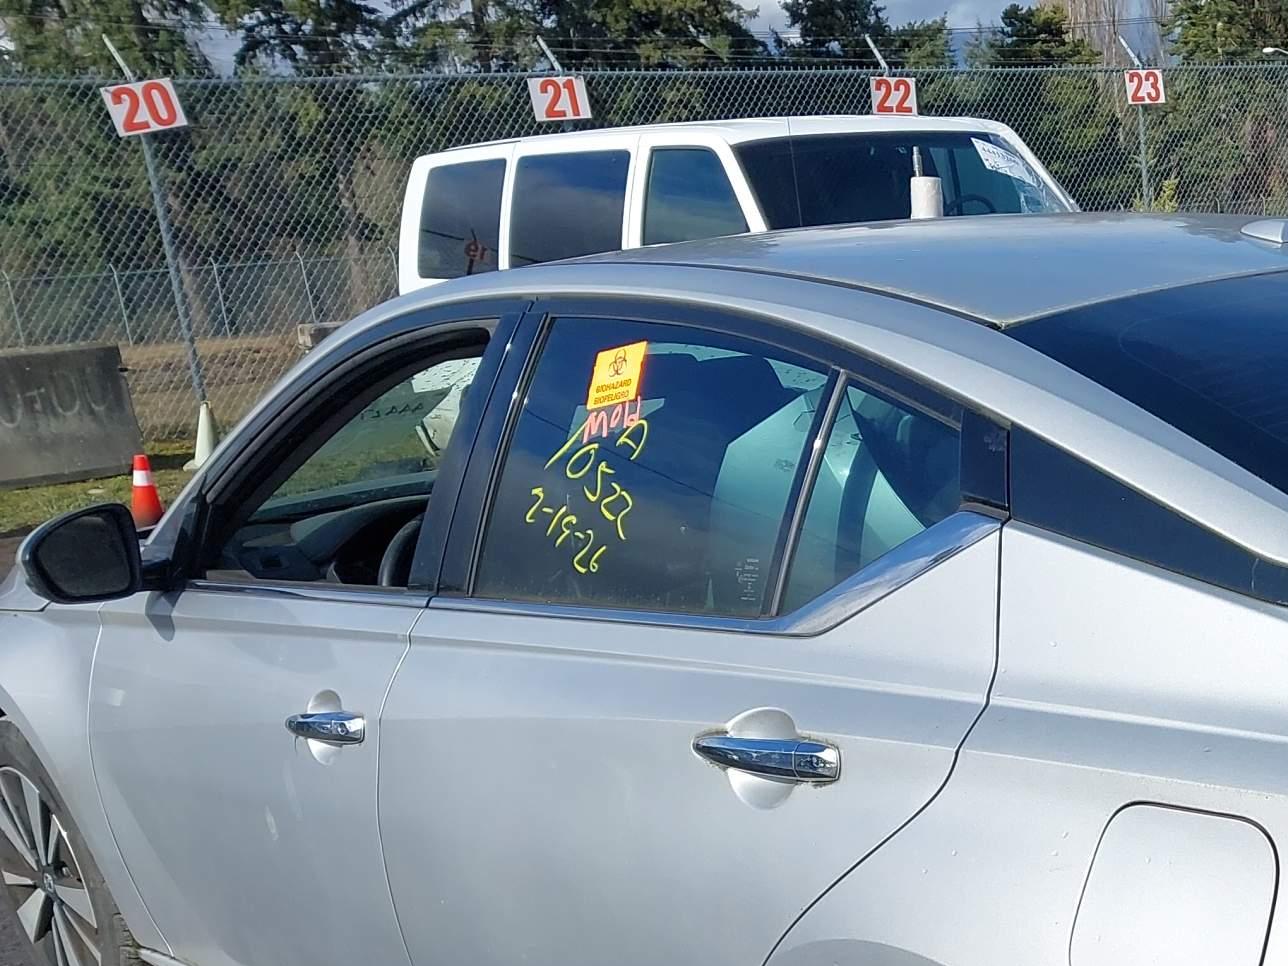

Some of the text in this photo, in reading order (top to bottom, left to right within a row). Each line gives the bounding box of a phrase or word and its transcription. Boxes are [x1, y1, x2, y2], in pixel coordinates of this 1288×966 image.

[540, 79, 581, 119] 21
[875, 79, 913, 114] 22
[1129, 71, 1160, 103] 23
[112, 81, 176, 132] 20
[595, 379, 632, 394] BIOHAZARD
